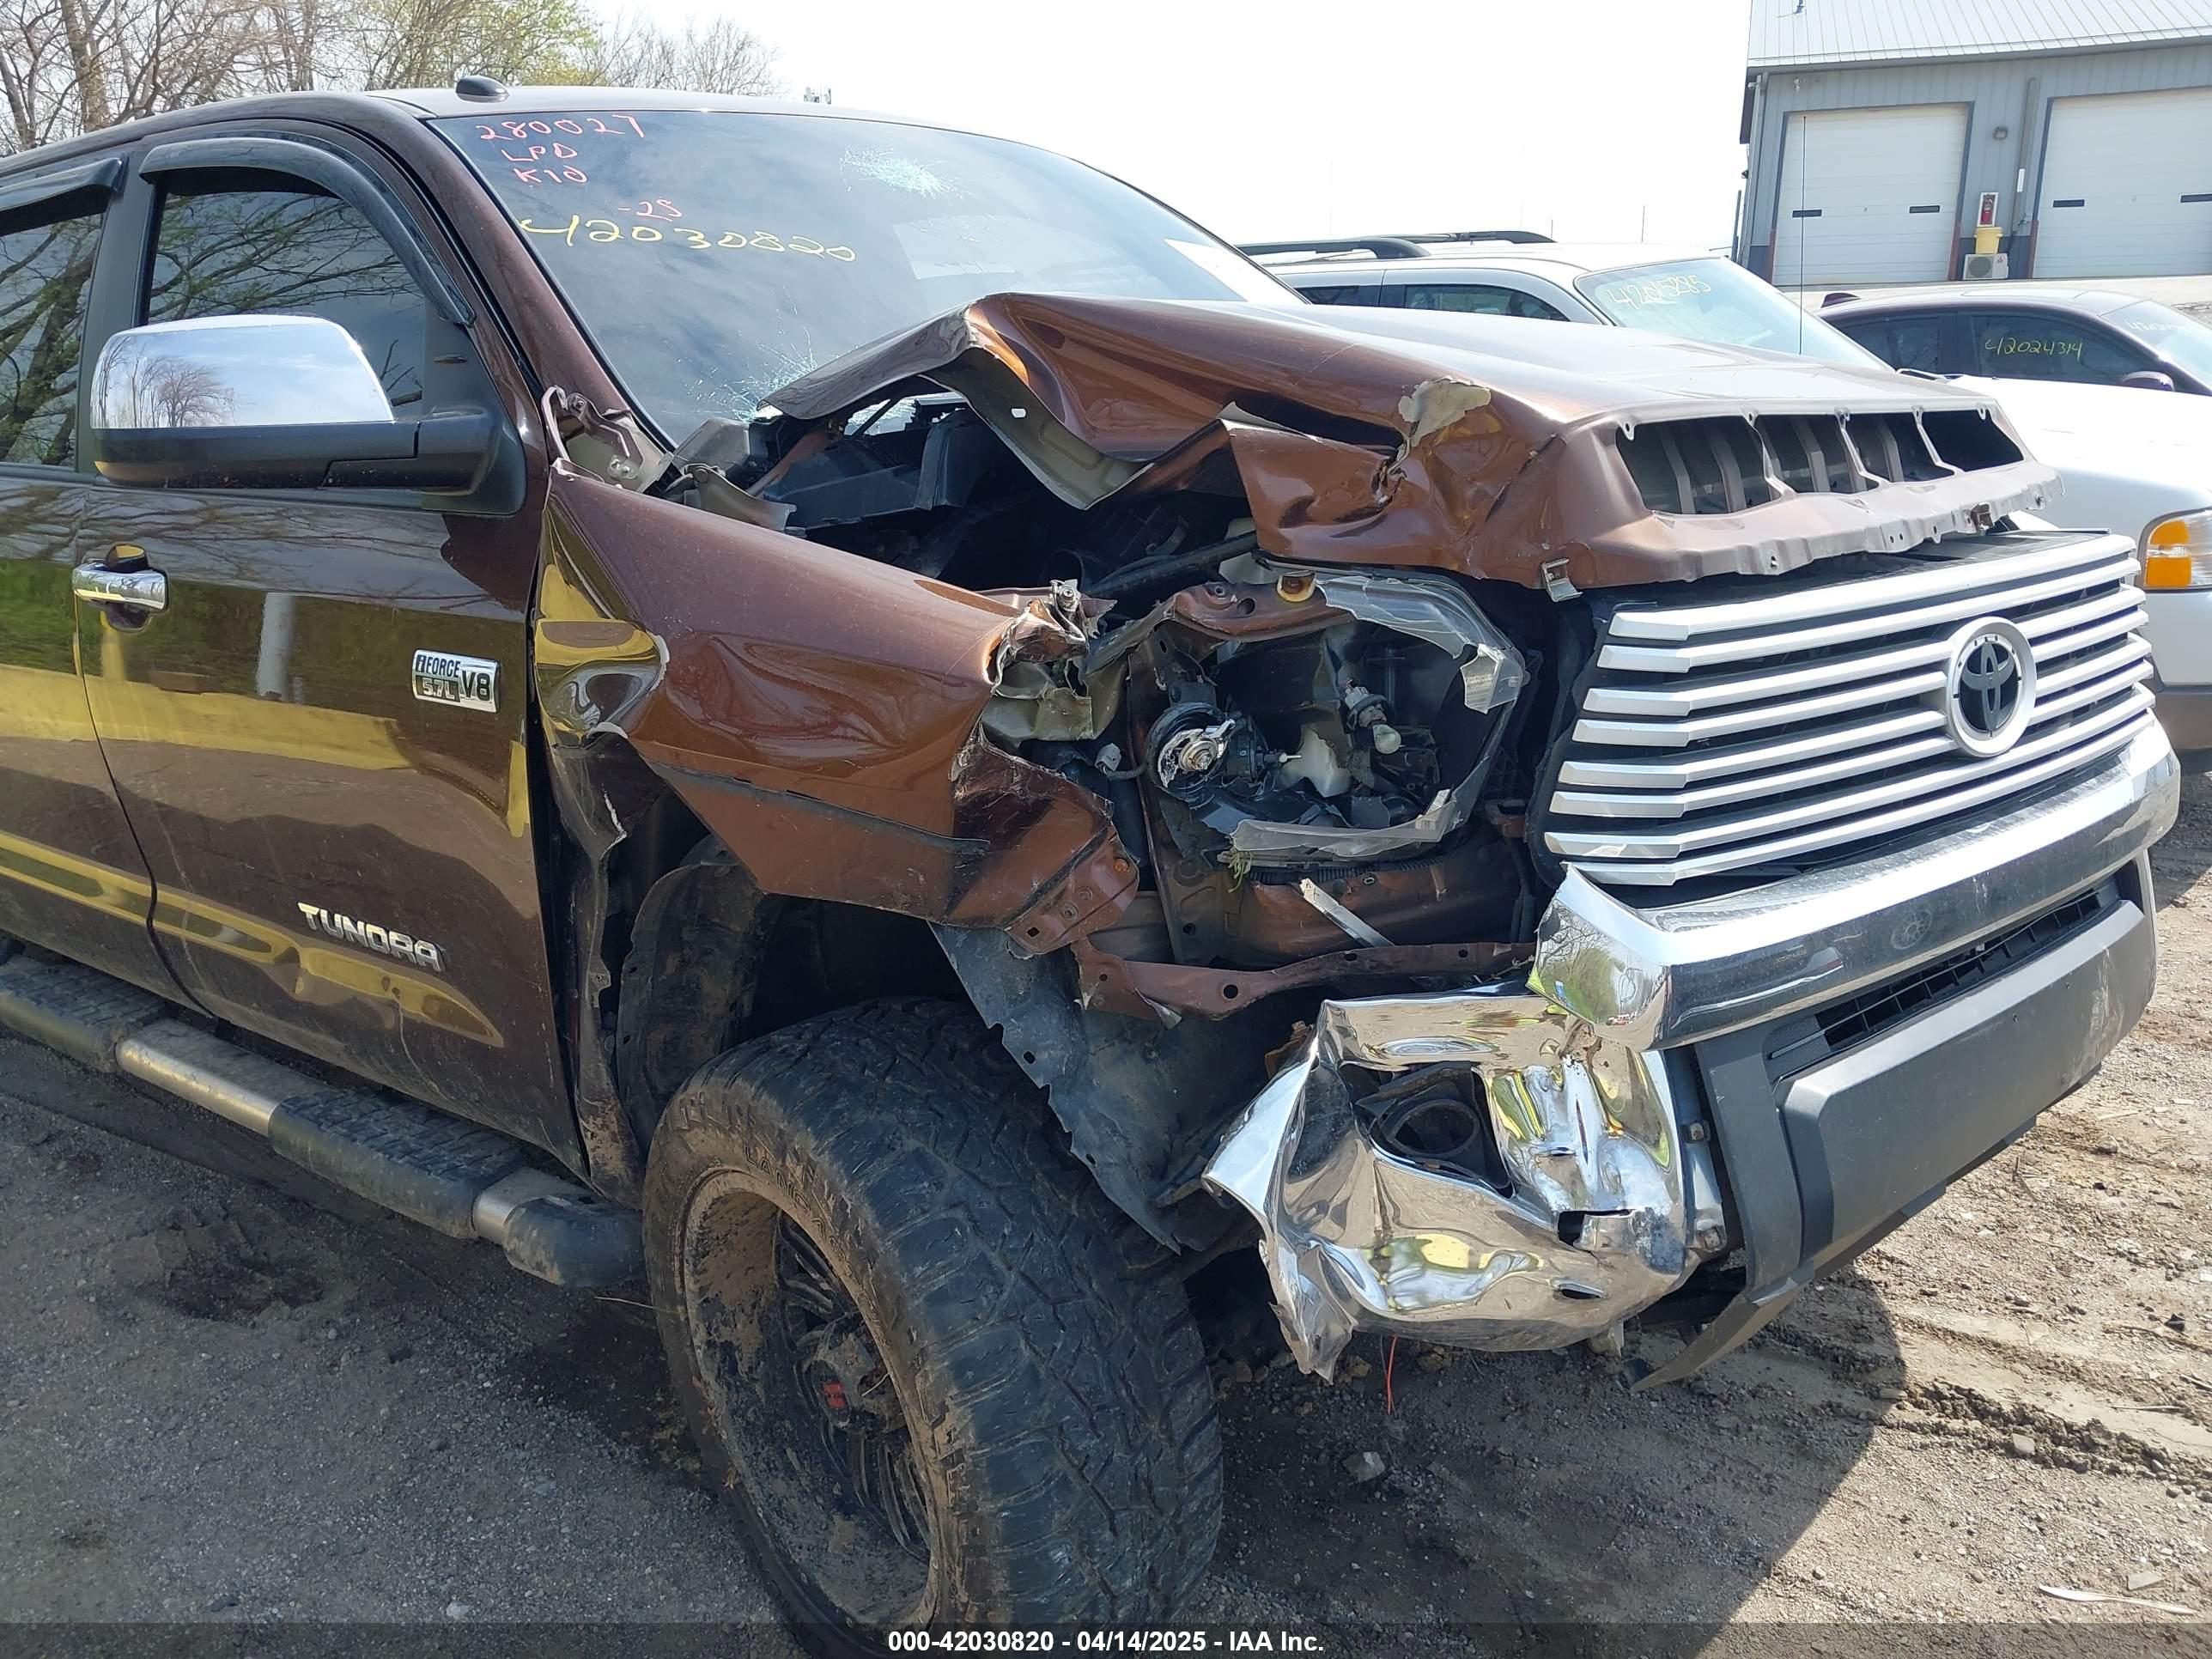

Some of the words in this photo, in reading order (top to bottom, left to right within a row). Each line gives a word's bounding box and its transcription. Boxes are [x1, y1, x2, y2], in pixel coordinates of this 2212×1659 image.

[476, 114, 645, 140] 280027
[501, 142, 578, 162] LPD
[518, 214, 857, 261] 42030820
[1984, 336, 2084, 361] 42024314
[422, 677, 456, 700] 5.7L
[462, 670, 490, 701] V8
[297, 902, 447, 972] TUNDRA
